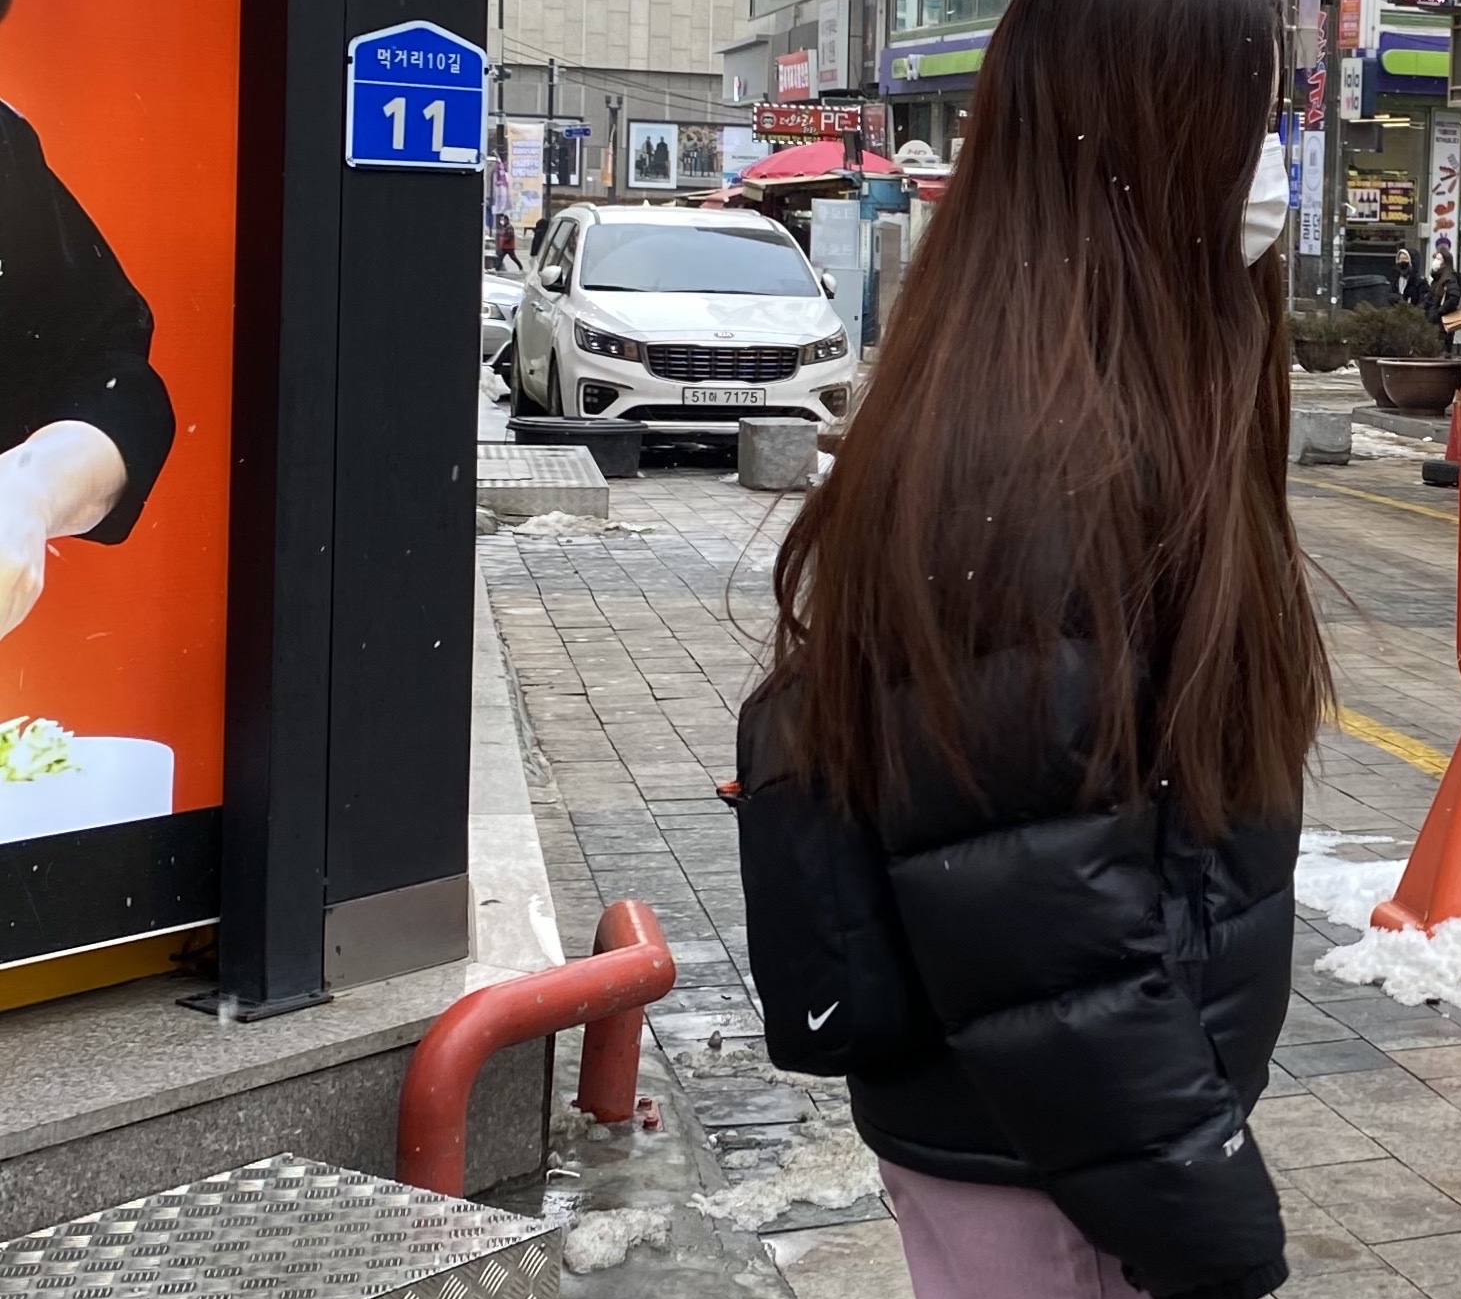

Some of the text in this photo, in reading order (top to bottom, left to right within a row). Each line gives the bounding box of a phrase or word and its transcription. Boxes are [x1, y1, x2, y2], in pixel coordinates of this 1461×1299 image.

[376, 48, 462, 75] 먹거리10길
[382, 96, 446, 154] 11
[723, 390, 759, 405] 7175
